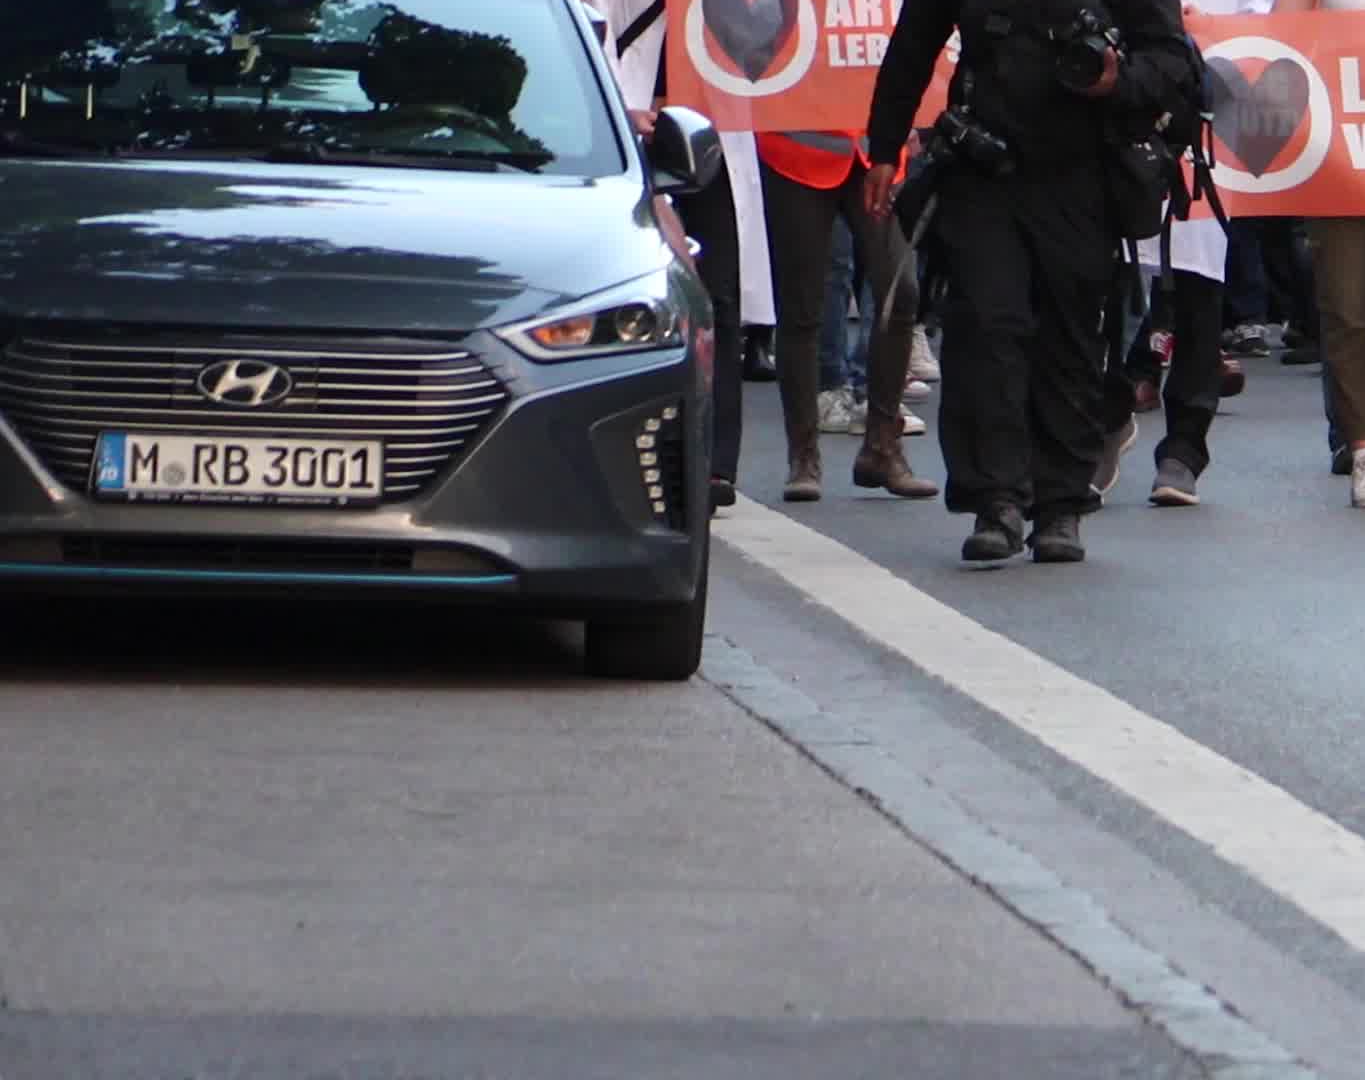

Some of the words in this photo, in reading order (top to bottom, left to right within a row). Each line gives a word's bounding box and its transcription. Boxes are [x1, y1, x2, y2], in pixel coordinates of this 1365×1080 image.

[827, 33, 890, 66] LEB
[130, 442, 160, 485] M
[192, 443, 250, 487] RB
[261, 445, 375, 490] 3001
